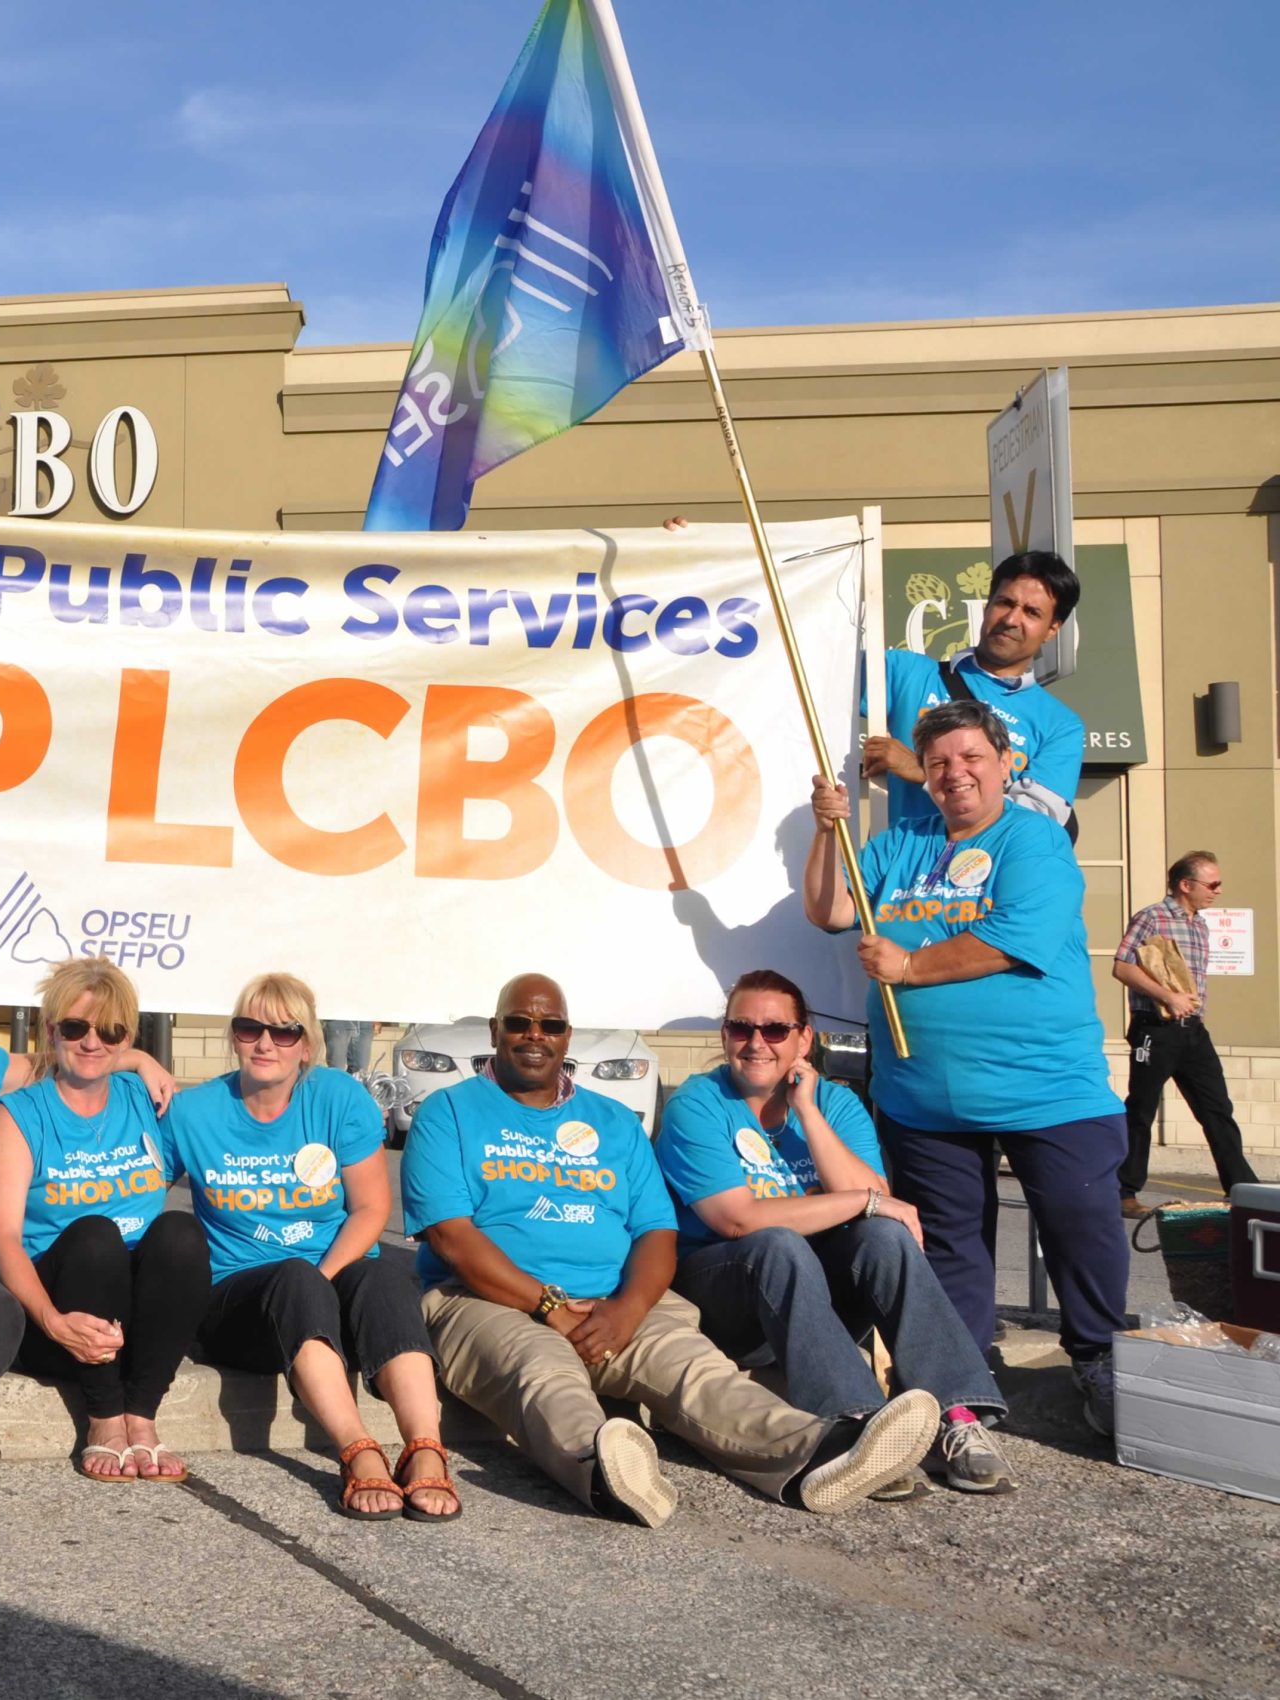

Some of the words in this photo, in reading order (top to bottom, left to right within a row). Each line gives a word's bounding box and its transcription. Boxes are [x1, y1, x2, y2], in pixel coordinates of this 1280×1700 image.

[992, 399, 1044, 478] PEDESTRIAN
[341, 564, 761, 659] Services
[989, 705, 1019, 725] your
[1082, 731, 1132, 748] RES
[105, 668, 763, 890] LCBO
[81, 909, 191, 940] OPSEU
[110, 1145, 138, 1159] your
[223, 1153, 280, 1169] Support
[484, 1145, 536, 1159] Public
[47, 1164, 96, 1179] Public
[96, 1155, 152, 1176] Service
[481, 1160, 551, 1182] SHOP
[205, 1170, 258, 1185] Public
[44, 1180, 113, 1205] SHOP
[204, 1187, 273, 1211] SHOP
[563, 1203, 595, 1215] OPSEU
[563, 1213, 595, 1224] SEFPO
[282, 1221, 312, 1236] OPSEU
